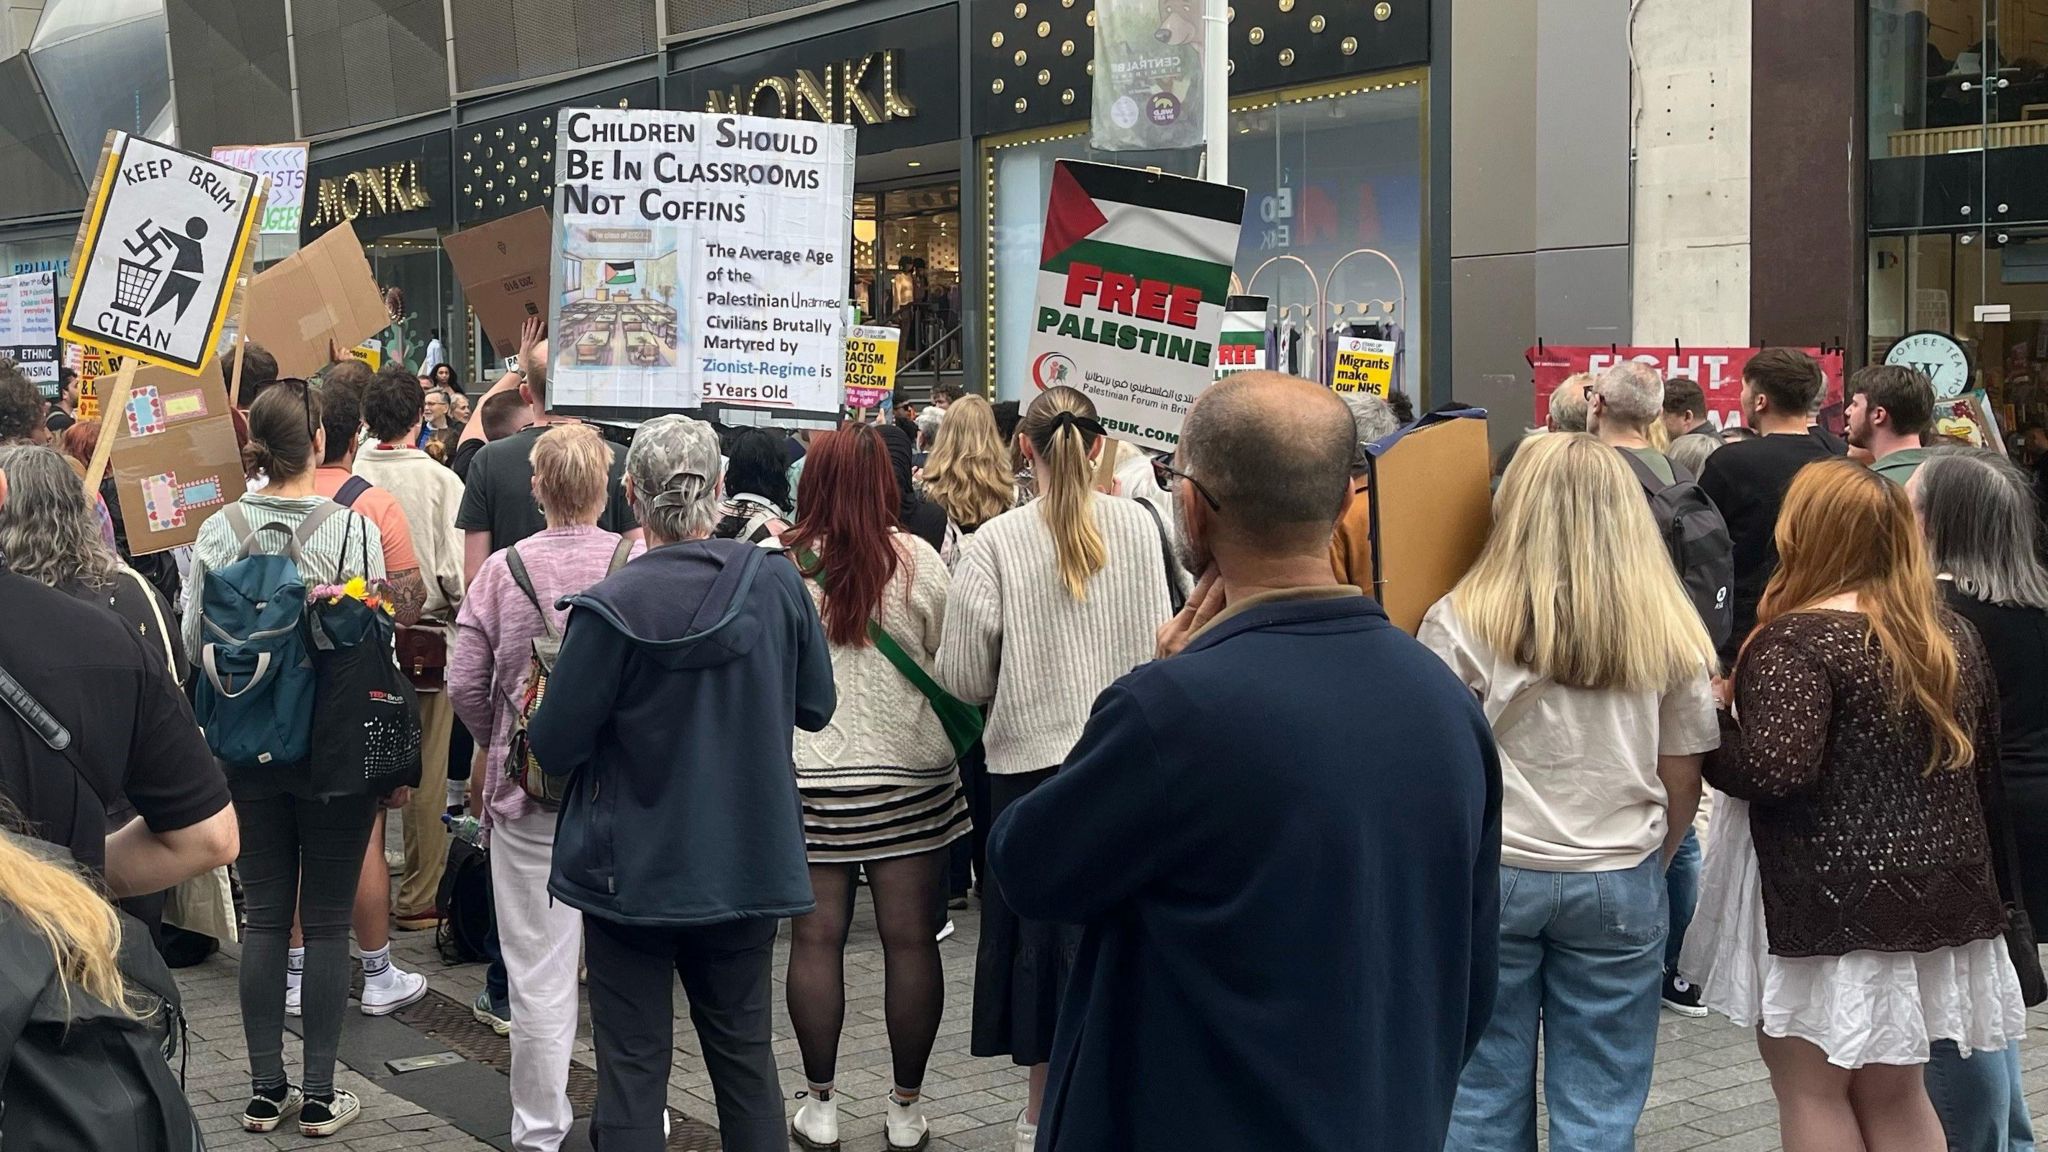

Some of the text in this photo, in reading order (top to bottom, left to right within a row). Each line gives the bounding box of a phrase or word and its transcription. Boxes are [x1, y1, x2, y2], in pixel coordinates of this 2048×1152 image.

[568, 113, 818, 156] CHILDREN SHOULD
[566, 149, 819, 190] BE IN CLASSROOMS
[122, 158, 237, 213] KEEP BRUM
[563, 184, 746, 223] NOT COFFINS
[706, 243, 834, 265] The Average Age
[706, 267, 752, 282] of the
[707, 291, 789, 309] Palestinian
[1064, 262, 1203, 330] FREE
[97, 311, 172, 351] CLEAN
[706, 315, 832, 336] Civilians Brutally
[704, 335, 799, 356] Martyred by
[862, 341, 876, 353] TO
[1036, 306, 1213, 368] PALESTINE
[21, 348, 53, 360] ETHNIC
[1218, 344, 1256, 365] REE
[1339, 353, 1389, 370] Migrants
[1890, 337, 1962, 369] COFFEE TEA
[702, 358, 832, 379] Zionist-Regime is
[861, 363, 874, 374] TO
[1337, 369, 1368, 381] make
[844, 373, 887, 386] ASCISM
[1335, 381, 1381, 395] our NHS
[703, 382, 788, 399] 5 Years Old
[1082, 383, 1188, 416] Palestinian Forum in Brit
